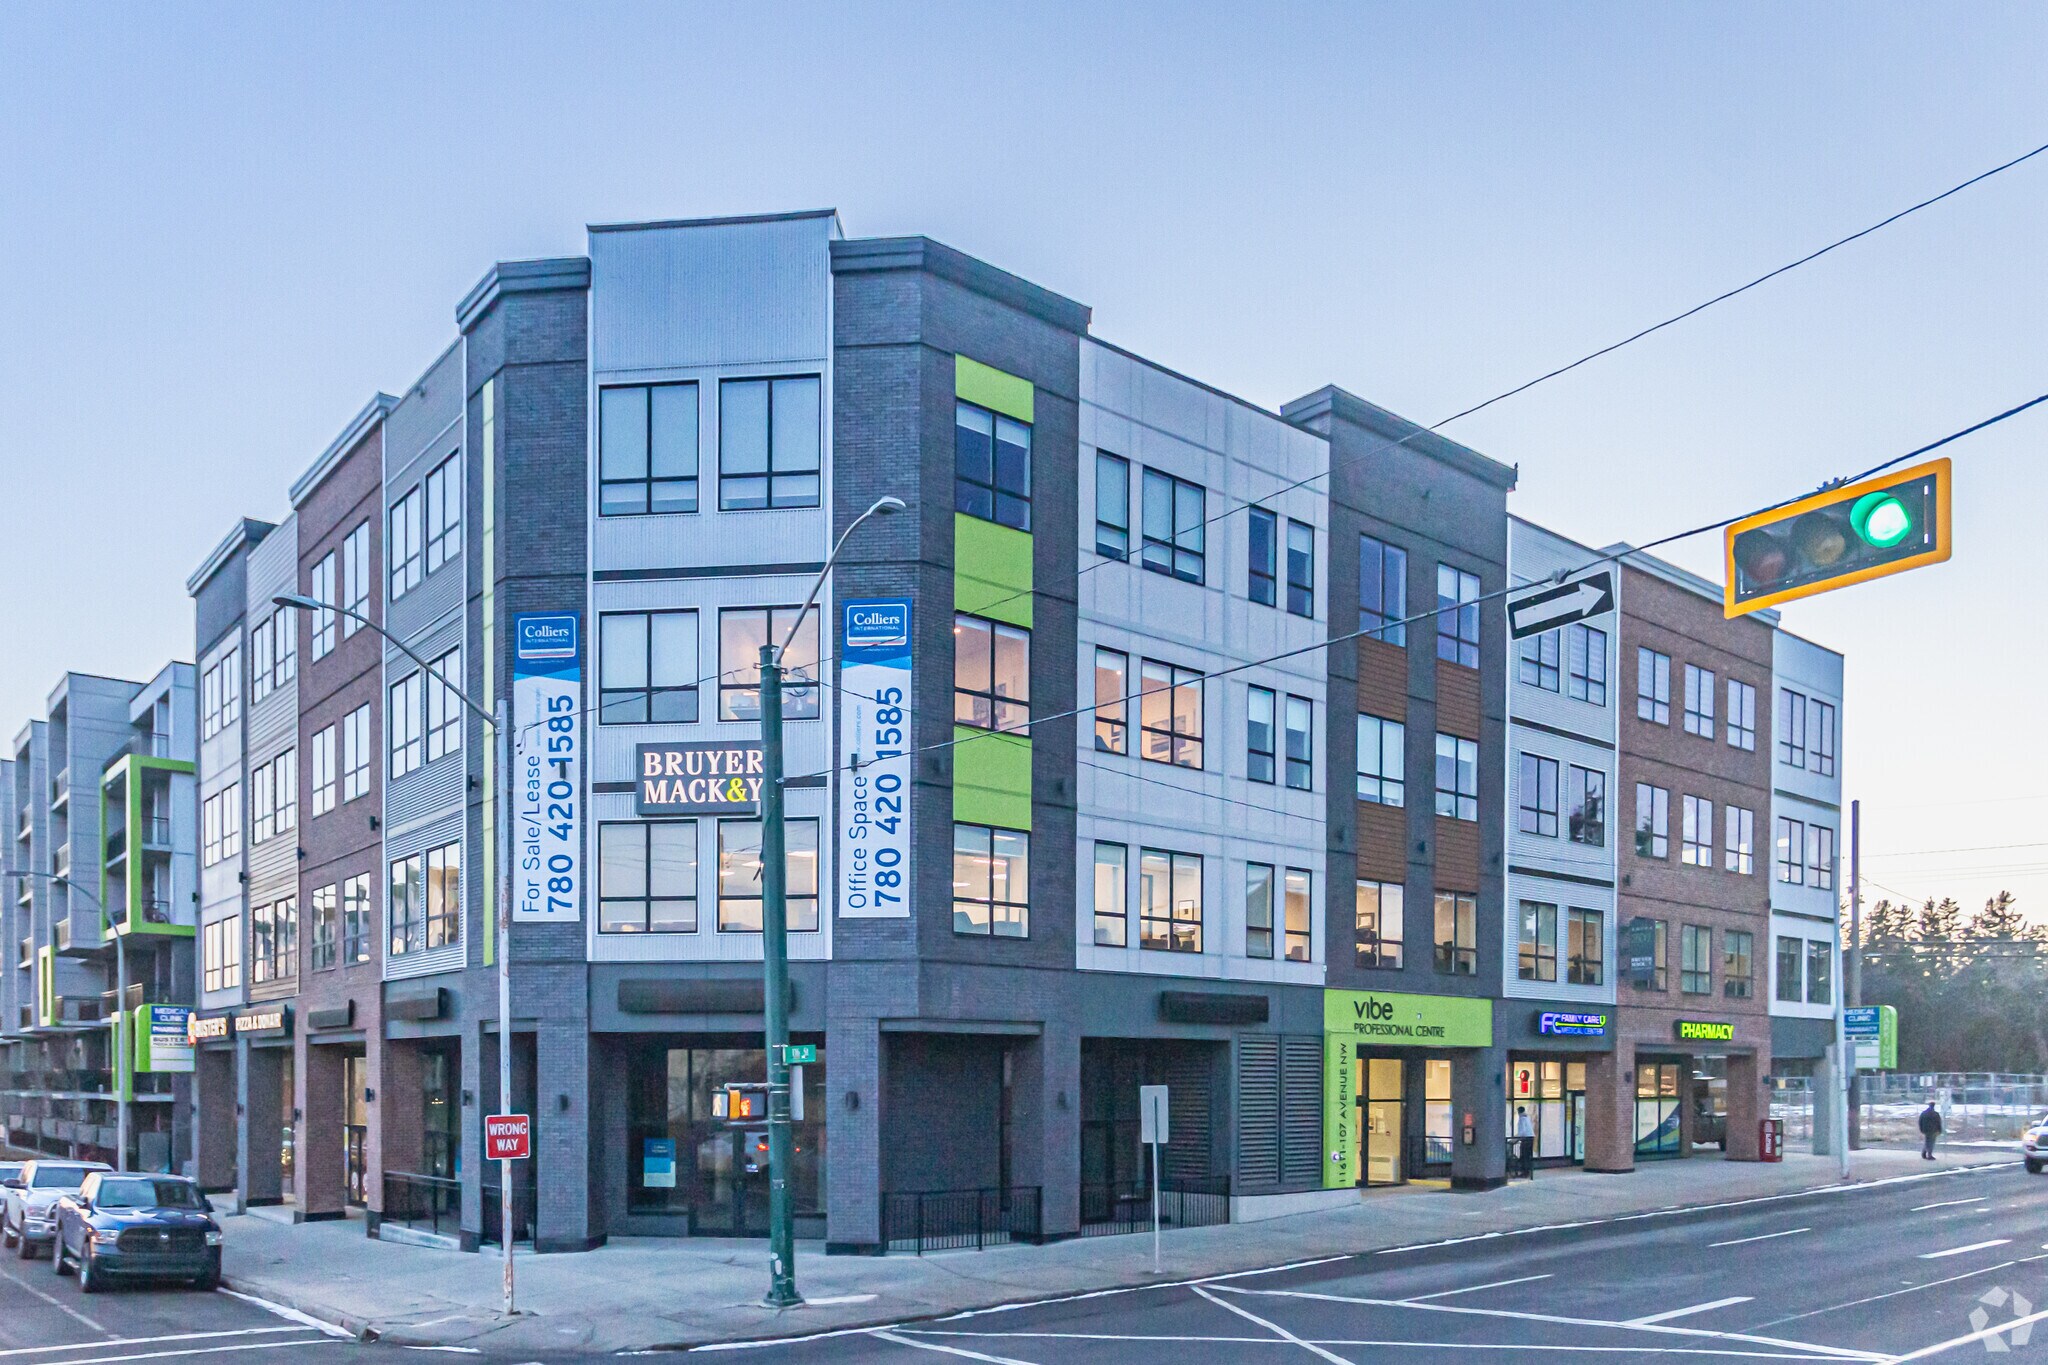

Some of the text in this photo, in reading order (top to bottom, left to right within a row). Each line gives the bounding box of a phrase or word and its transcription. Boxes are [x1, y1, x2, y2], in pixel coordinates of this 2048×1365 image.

[853, 613, 900, 625] Colliers
[525, 625, 569, 637] Colliers
[643, 750, 763, 776] BRUYER
[643, 777, 763, 804] MACK&Y
[875, 687, 902, 907] 780 420 1585
[547, 695, 573, 912] 780 420 1585
[521, 756, 542, 912] For Sale/Lease
[848, 776, 872, 908] Office Space
[1353, 996, 1393, 1020] vibe
[1561, 1014, 1600, 1024] FAMILY CARE
[1354, 1023, 1445, 1038] PROFESSIONAL CENTRE
[1681, 1022, 1734, 1040] PHARMACY
[1340, 1043, 1347, 1065] NW
[1339, 1068, 1348, 1119] AVENUE
[488, 1122, 527, 1136] WRONG
[496, 1138, 519, 1151] WAY
